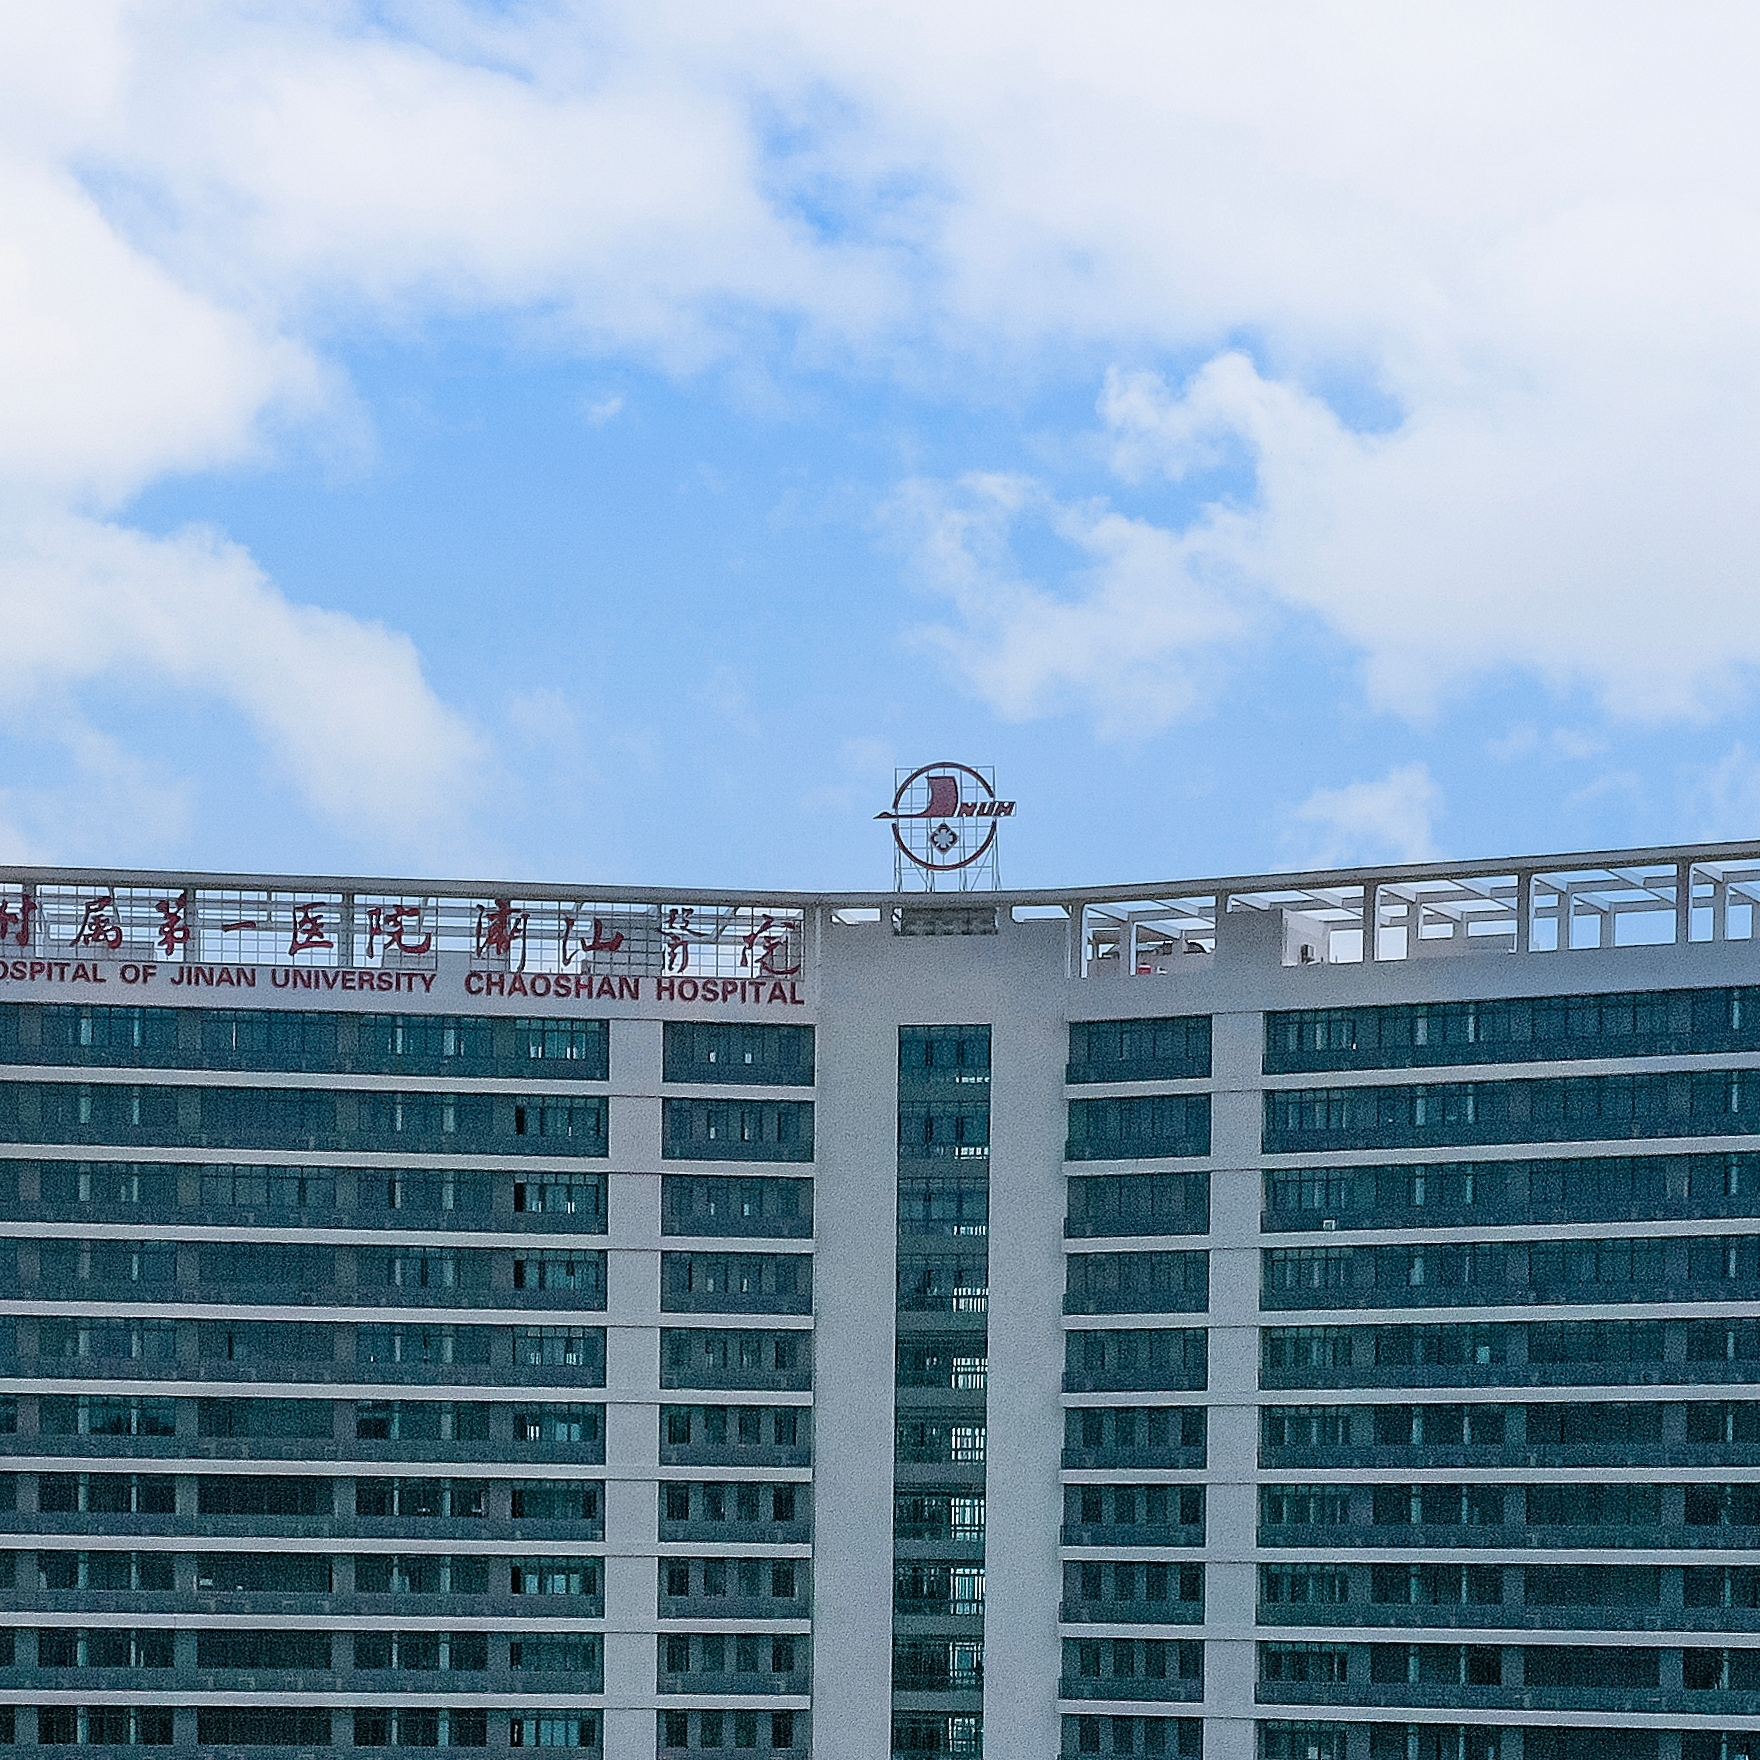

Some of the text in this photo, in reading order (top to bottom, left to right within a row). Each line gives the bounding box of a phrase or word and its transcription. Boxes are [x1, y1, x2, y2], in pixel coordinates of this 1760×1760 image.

[119, 962, 158, 984] OF
[170, 964, 257, 988] JINAN
[271, 968, 437, 994] UNIVERSITY
[465, 971, 640, 1001] CHAOSHAN
[655, 977, 805, 1006] HOSPITAL
